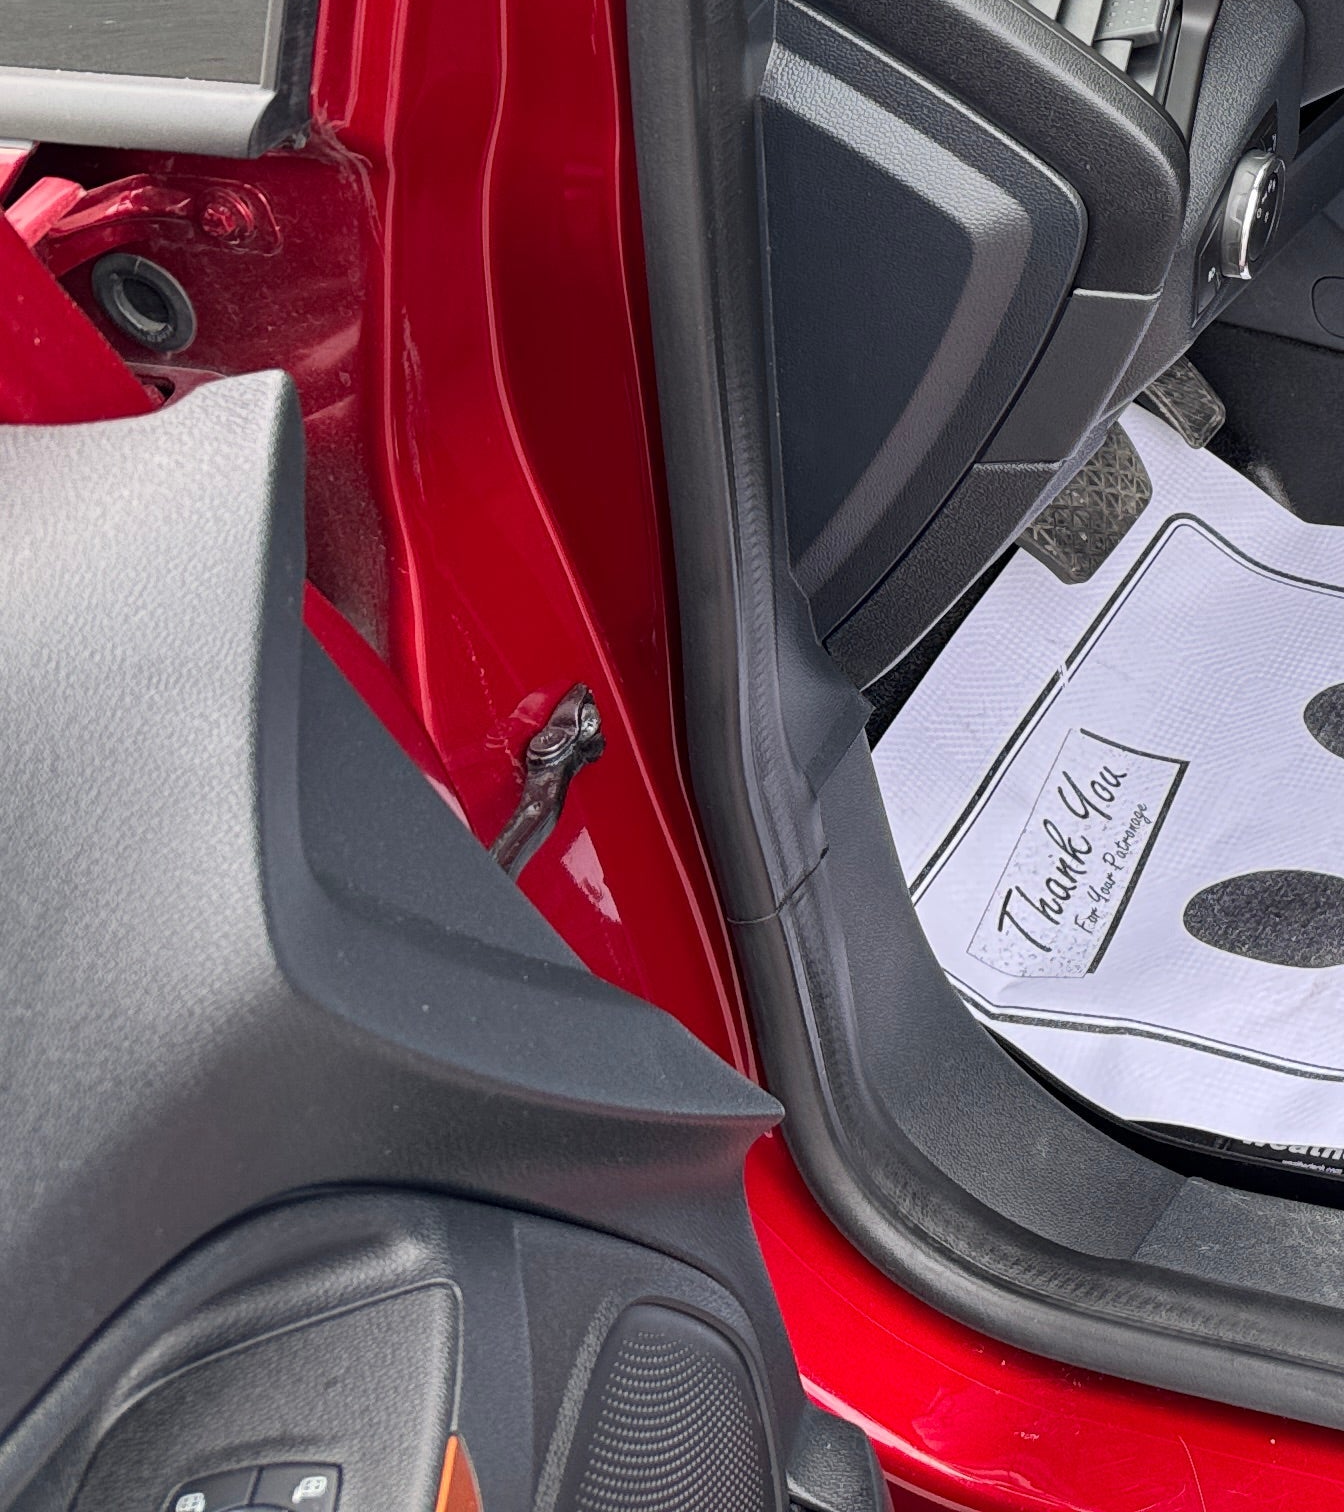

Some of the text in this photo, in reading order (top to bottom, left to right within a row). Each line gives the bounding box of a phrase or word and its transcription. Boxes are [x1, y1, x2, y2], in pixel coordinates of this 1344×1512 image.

[998, 765, 1127, 952] Thank You
[1074, 803, 1153, 934] For Your Patronage
